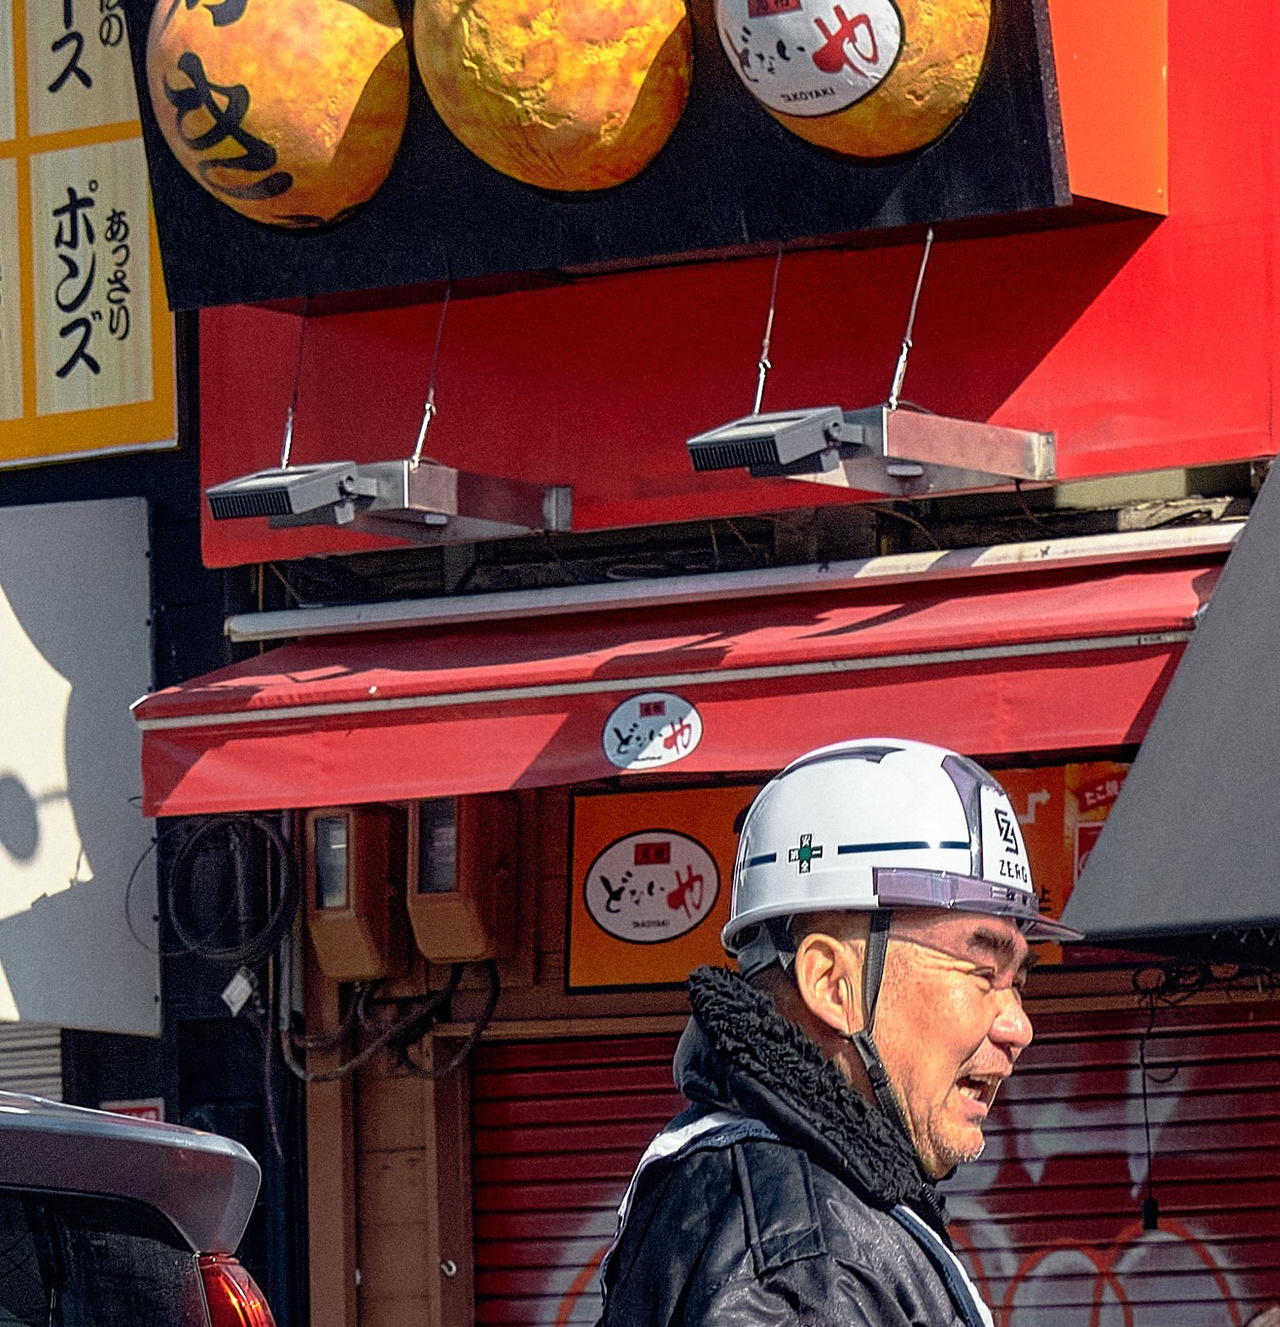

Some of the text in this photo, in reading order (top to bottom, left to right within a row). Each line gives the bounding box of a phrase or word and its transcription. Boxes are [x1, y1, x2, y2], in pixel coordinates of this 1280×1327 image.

[53, 179, 102, 380] ポンズ
[104, 207, 131, 341] あっさり
